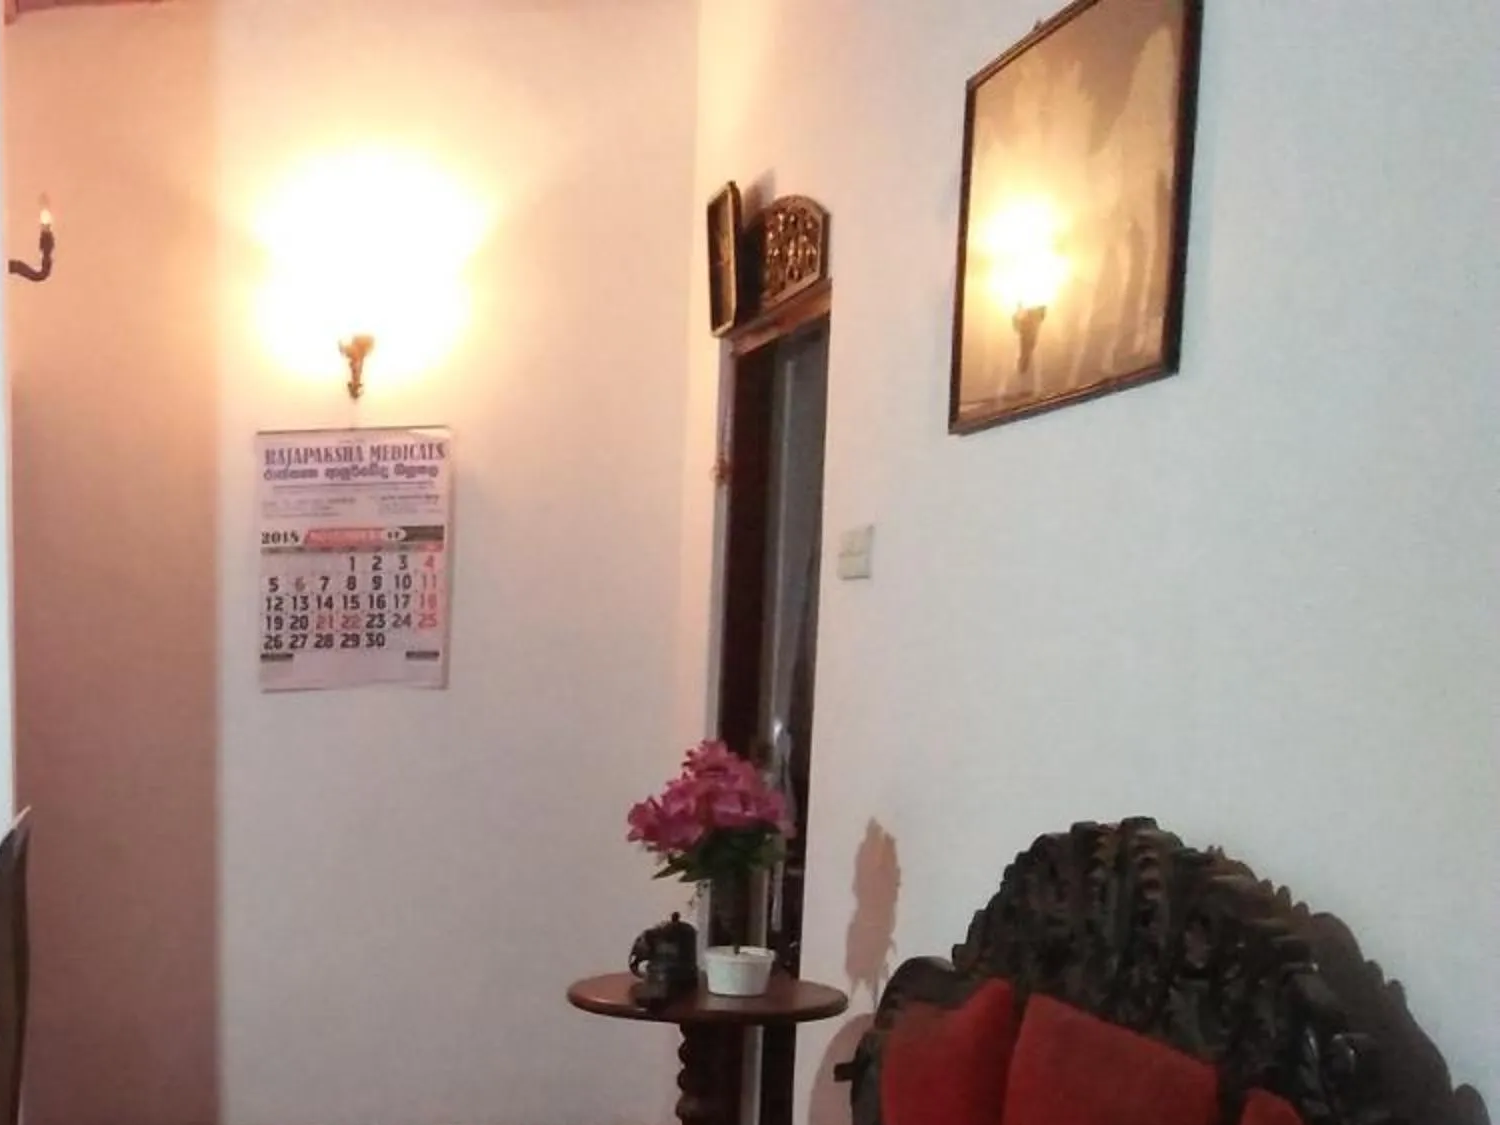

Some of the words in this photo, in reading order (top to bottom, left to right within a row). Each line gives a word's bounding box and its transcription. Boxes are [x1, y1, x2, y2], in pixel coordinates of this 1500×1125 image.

[265, 445, 364, 469] RAJAPAKSHA
[369, 442, 446, 462] MEDICALS
[349, 555, 355, 571] 1
[372, 555, 382, 571] 2
[399, 555, 408, 571] 3
[424, 554, 435, 569] 4
[268, 578, 279, 593] 5
[295, 577, 306, 593] 6
[319, 576, 330, 592] 7
[346, 576, 357, 591] 8
[371, 575, 383, 591] 9
[394, 574, 412, 590] 10
[422, 574, 437, 589] 11
[266, 596, 284, 611] 12
[291, 595, 309, 611] 13
[316, 595, 333, 610] 14
[342, 595, 360, 610] 15
[368, 594, 386, 610] 16
[393, 594, 411, 609] 17
[420, 593, 438, 609] 18
[266, 615, 283, 631] 19
[289, 615, 309, 631] 20
[315, 614, 334, 630] 21
[341, 614, 361, 630] 22
[366, 613, 386, 629] 23
[391, 612, 412, 629] 24
[417, 612, 438, 628] 25
[263, 634, 284, 650] 26
[288, 634, 309, 649] 27
[314, 633, 334, 649] 28
[340, 632, 361, 648] 29
[365, 632, 386, 648] 30
